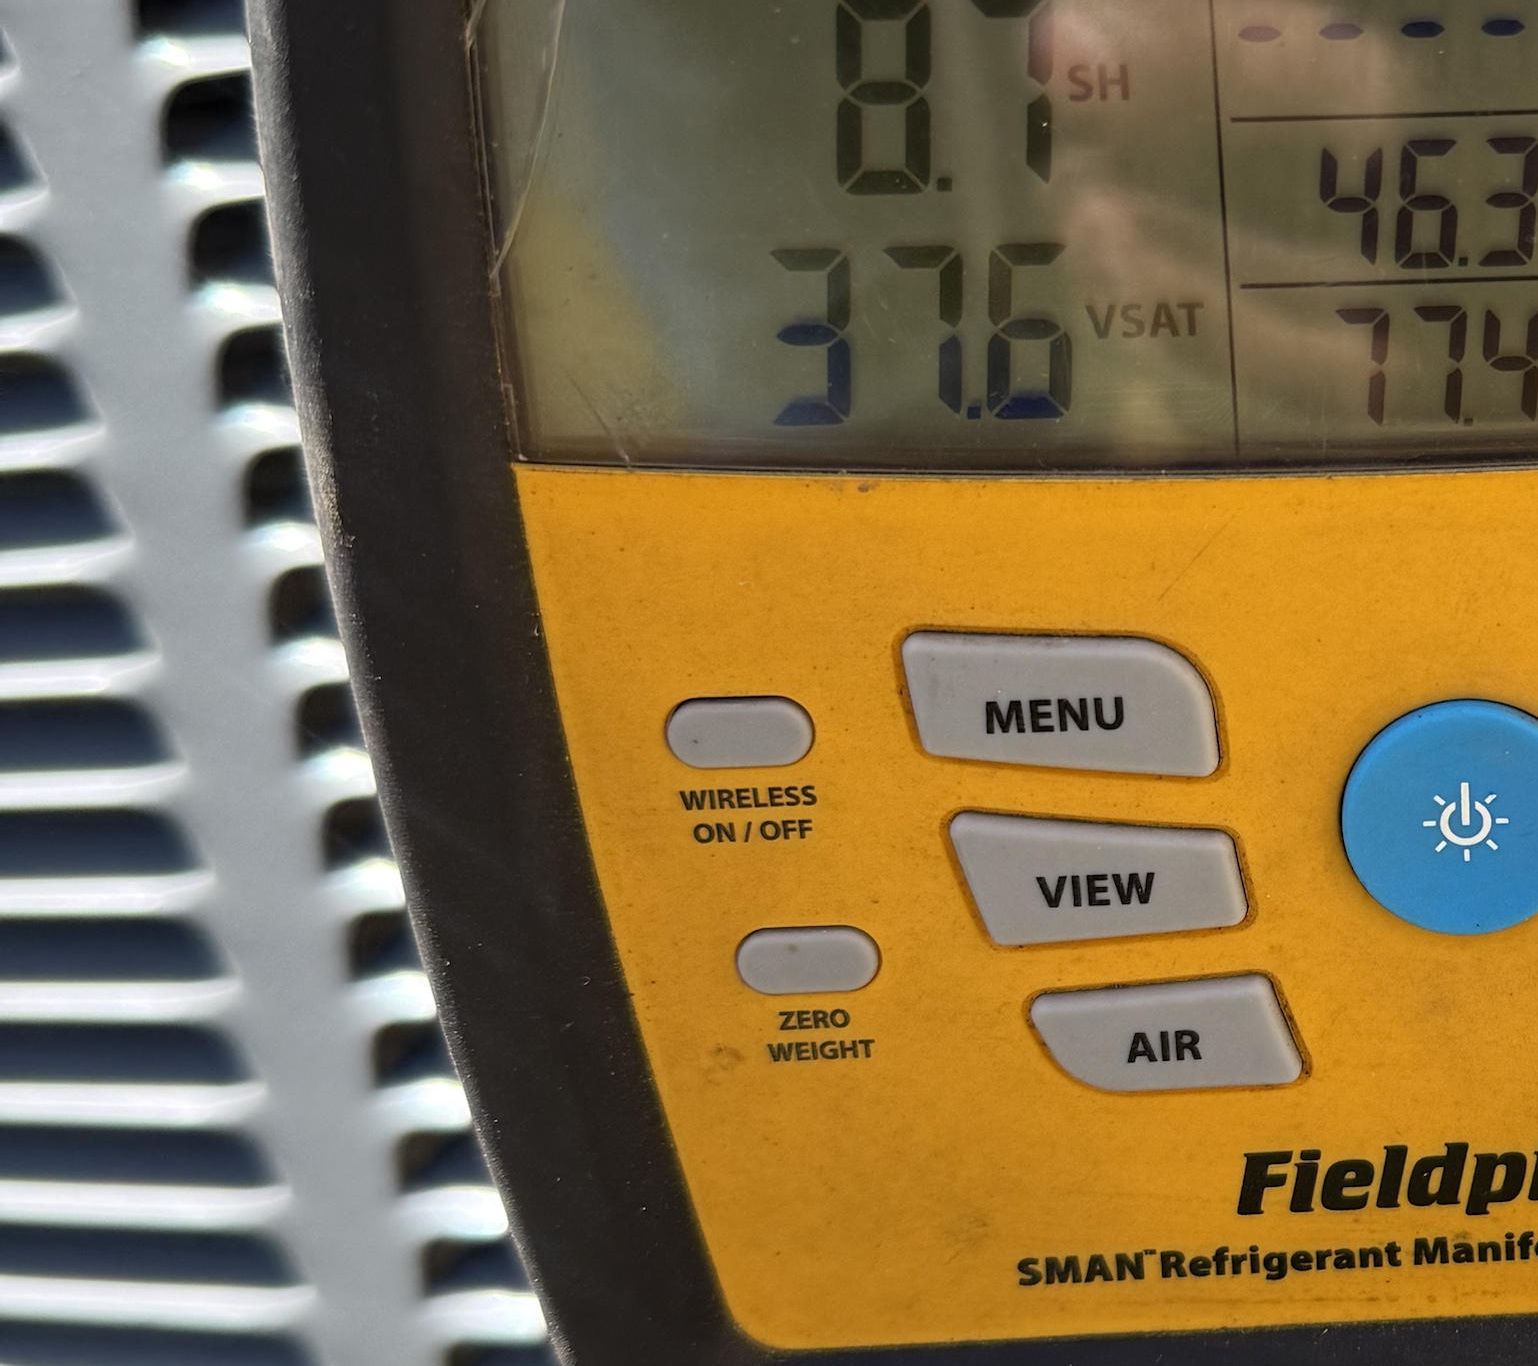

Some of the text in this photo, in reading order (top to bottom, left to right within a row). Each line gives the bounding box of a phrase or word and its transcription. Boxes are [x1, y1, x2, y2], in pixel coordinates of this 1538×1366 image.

[1067, 64, 1131, 102] SH
[770, 242, 1205, 426] 37.6 VSAT
[985, 696, 1125, 735] MENU
[680, 785, 818, 811] WIRELESS
[693, 823, 738, 845] ON
[759, 819, 814, 843] OFF
[1036, 872, 1156, 908] VIEW
[778, 1008, 851, 1031] ZERO
[767, 1038, 876, 1062] WEIGHT
[1126, 1029, 1203, 1064] AIR
[1160, 1241, 1402, 1282] Refrigerant
